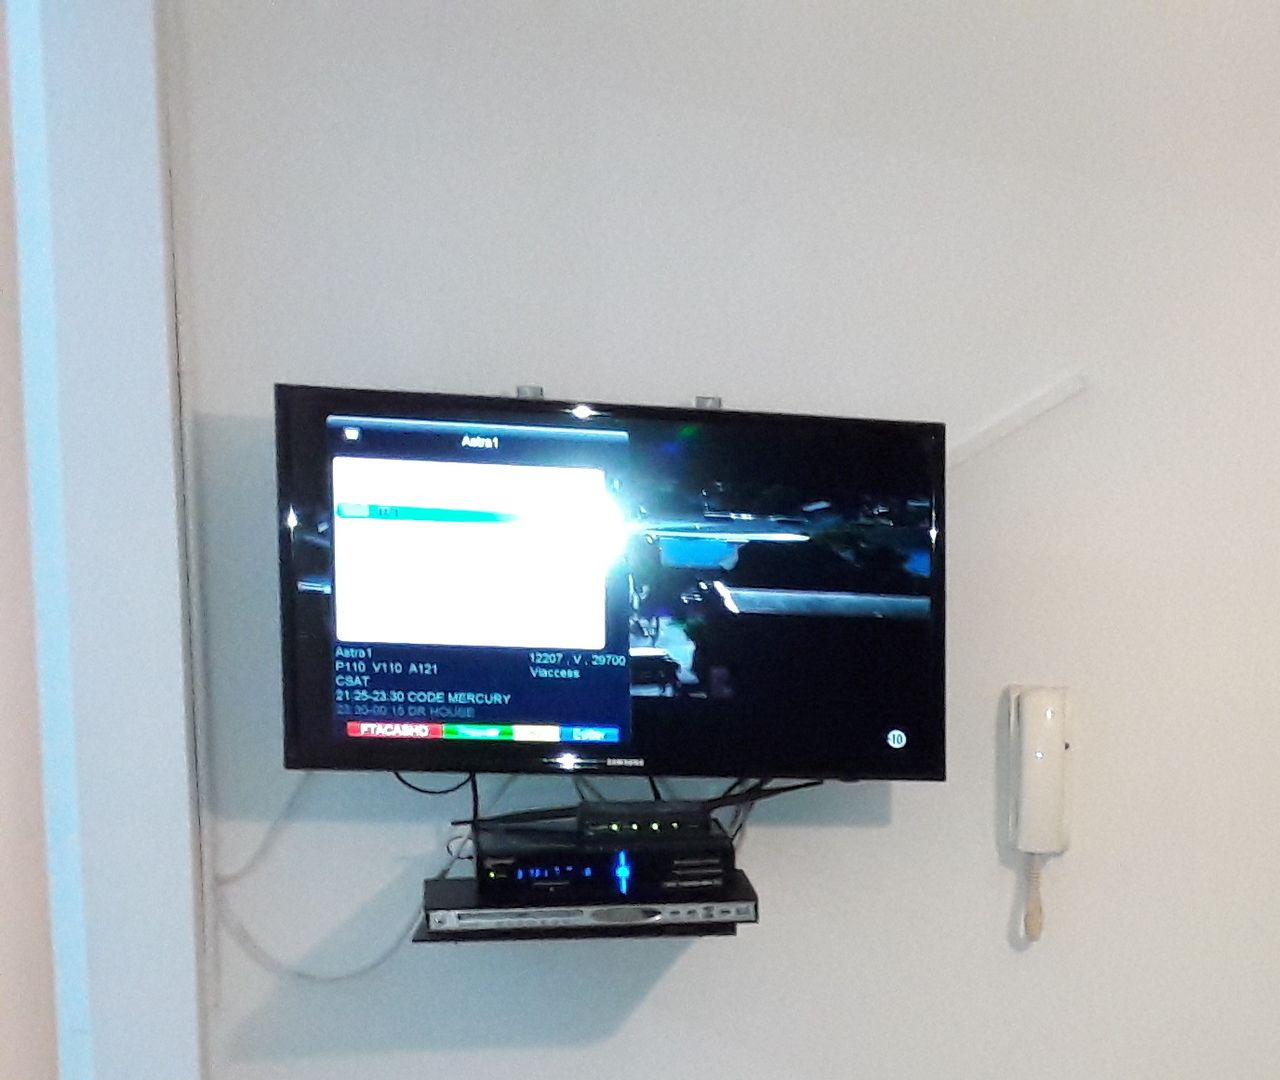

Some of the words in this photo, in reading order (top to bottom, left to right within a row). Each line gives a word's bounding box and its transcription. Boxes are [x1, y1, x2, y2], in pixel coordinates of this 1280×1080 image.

[529, 652, 564, 664] 12207
[591, 654, 626, 667] 29700
[335, 660, 366, 673] P110
[372, 661, 403, 674] V110
[408, 662, 438, 675] A121
[529, 666, 581, 679] Viaccess
[335, 675, 371, 687] CSAT
[408, 690, 445, 703] CODE
[448, 692, 511, 704] MERCURY
